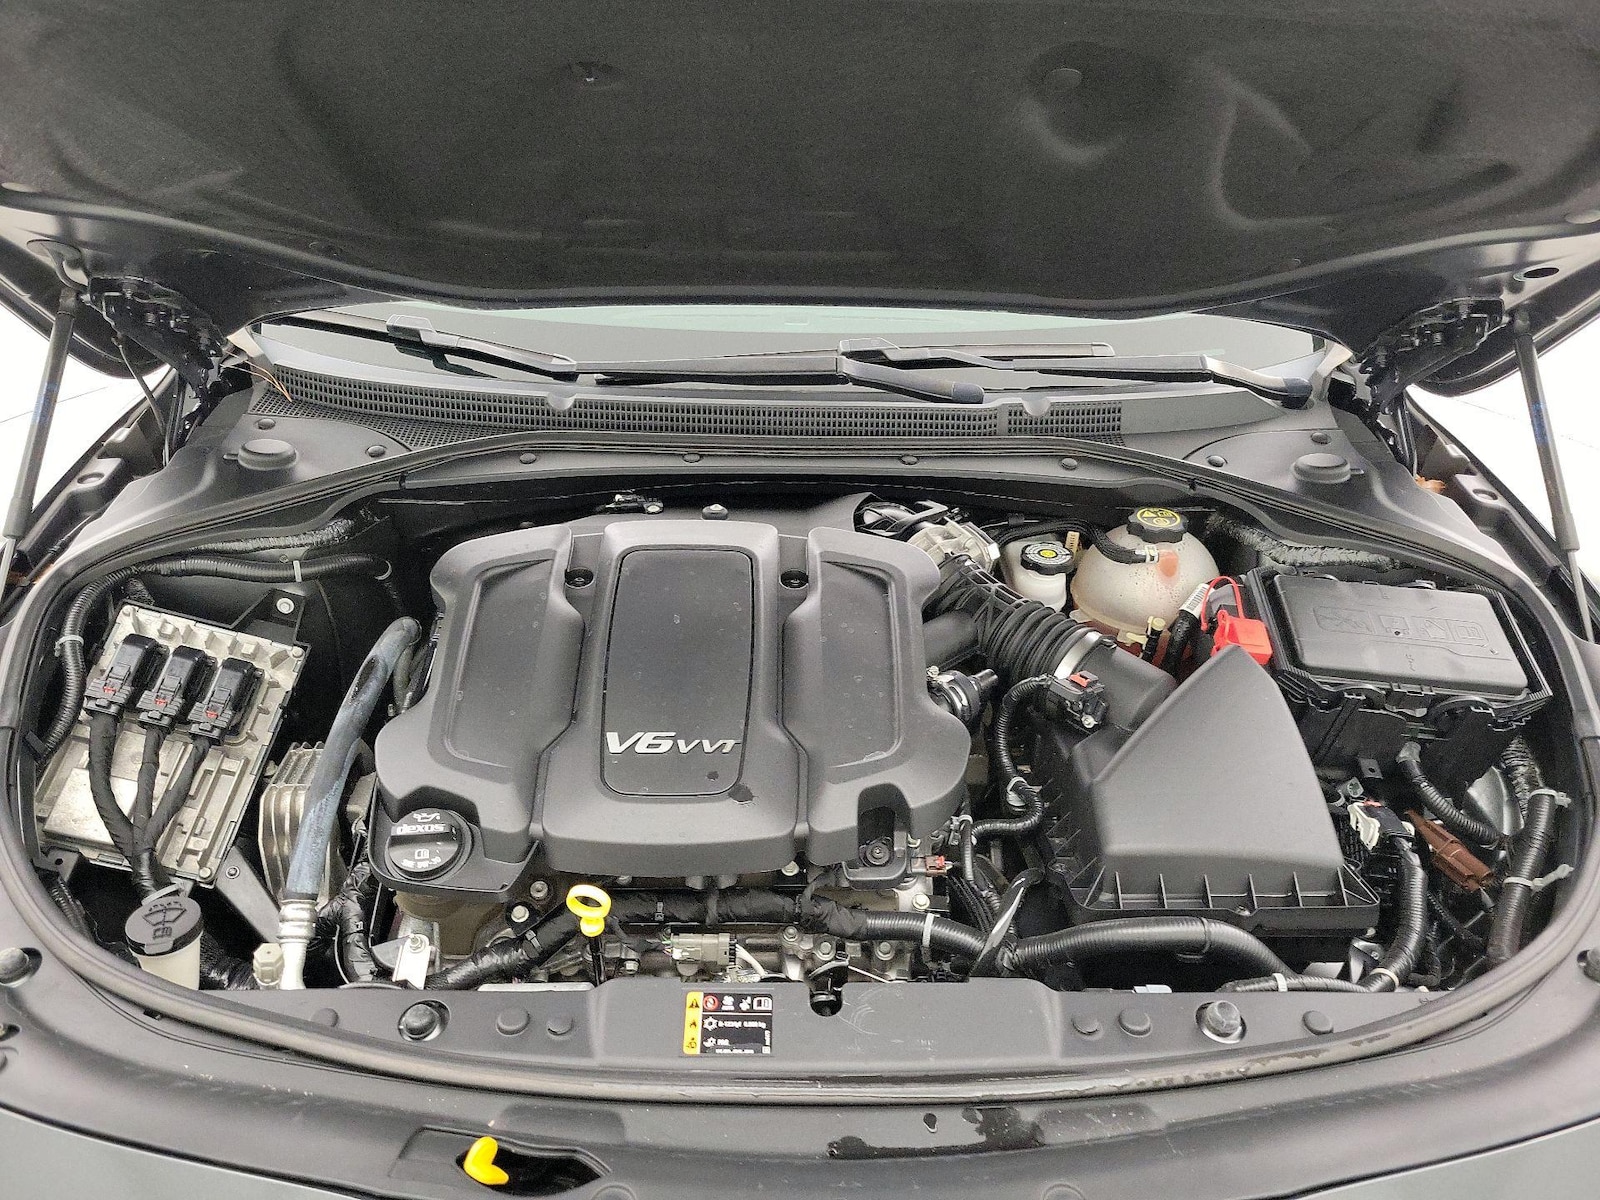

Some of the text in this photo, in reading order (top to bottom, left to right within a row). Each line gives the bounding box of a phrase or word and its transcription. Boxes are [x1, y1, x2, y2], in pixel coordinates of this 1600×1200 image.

[606, 731, 742, 754] V6 VVT
[396, 823, 446, 835] dexos
